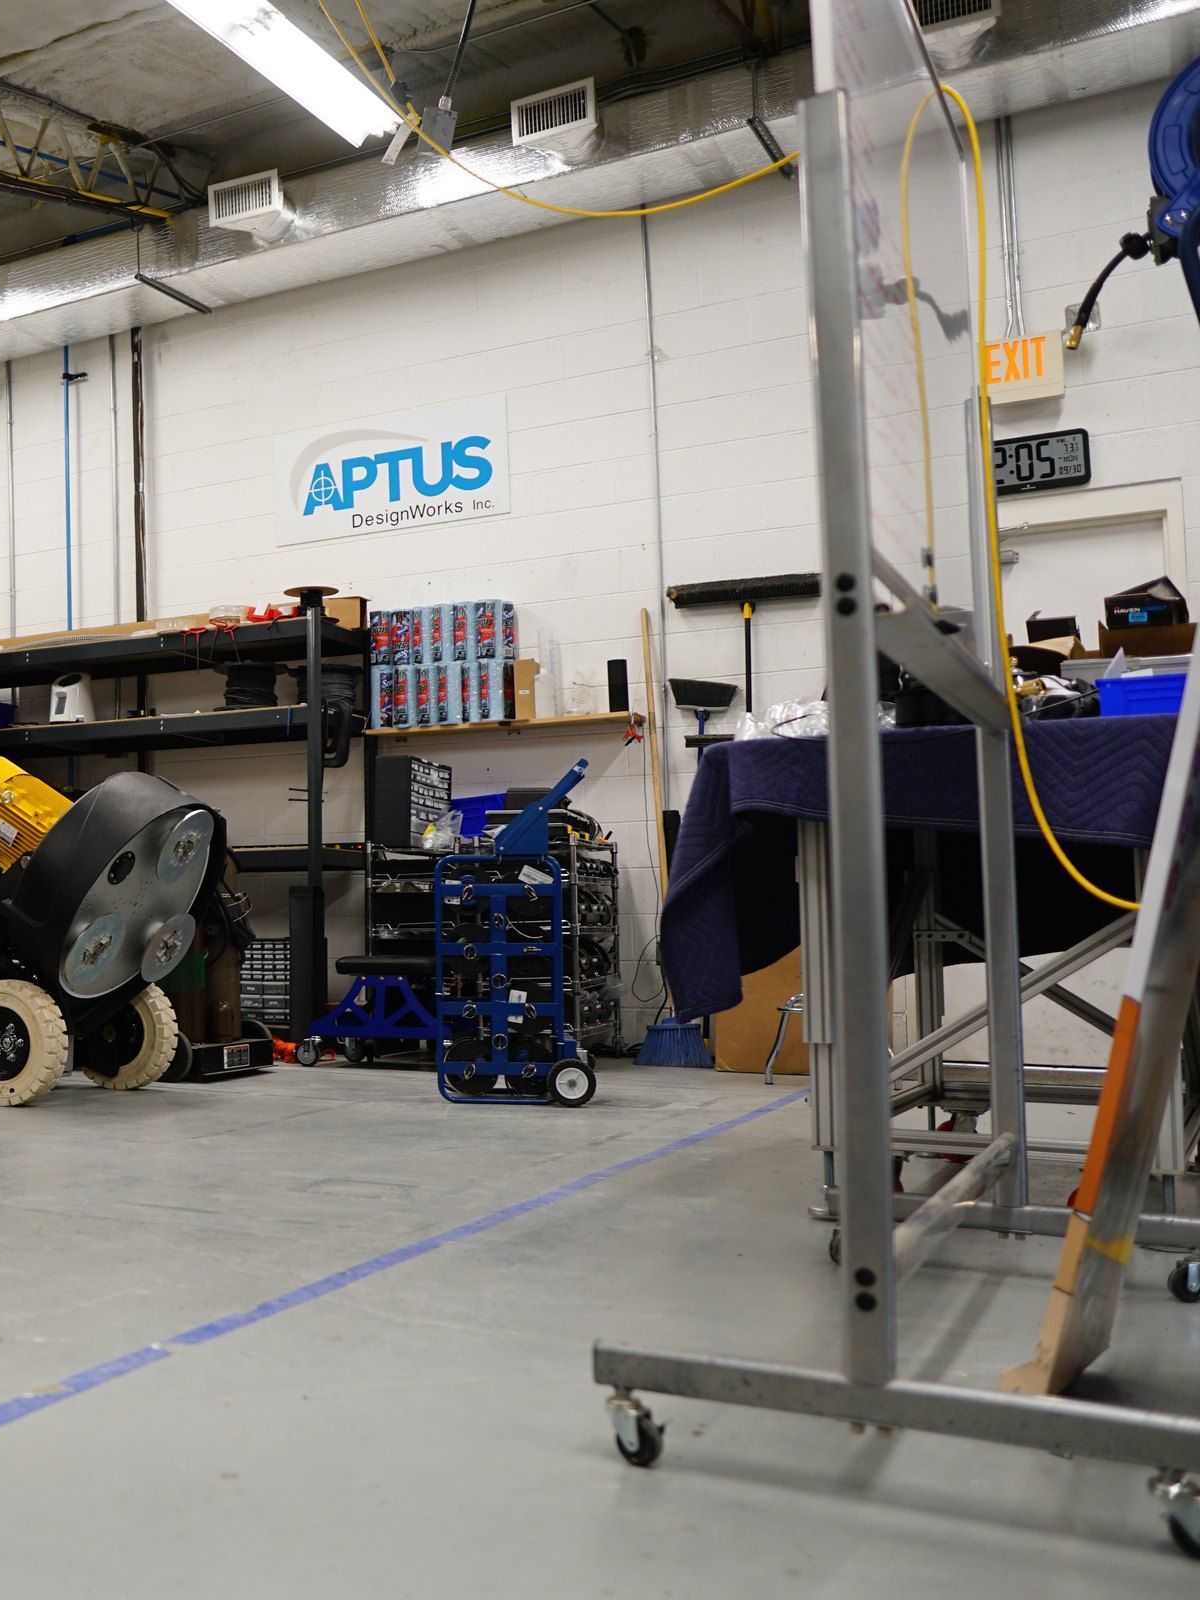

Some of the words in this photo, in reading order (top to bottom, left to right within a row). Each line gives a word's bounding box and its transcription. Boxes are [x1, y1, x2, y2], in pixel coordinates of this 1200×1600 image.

[985, 336, 1046, 384] EXIT
[303, 435, 493, 516] APTUS
[352, 499, 463, 529] DesignWorks
[472, 498, 495, 511] Inc.
